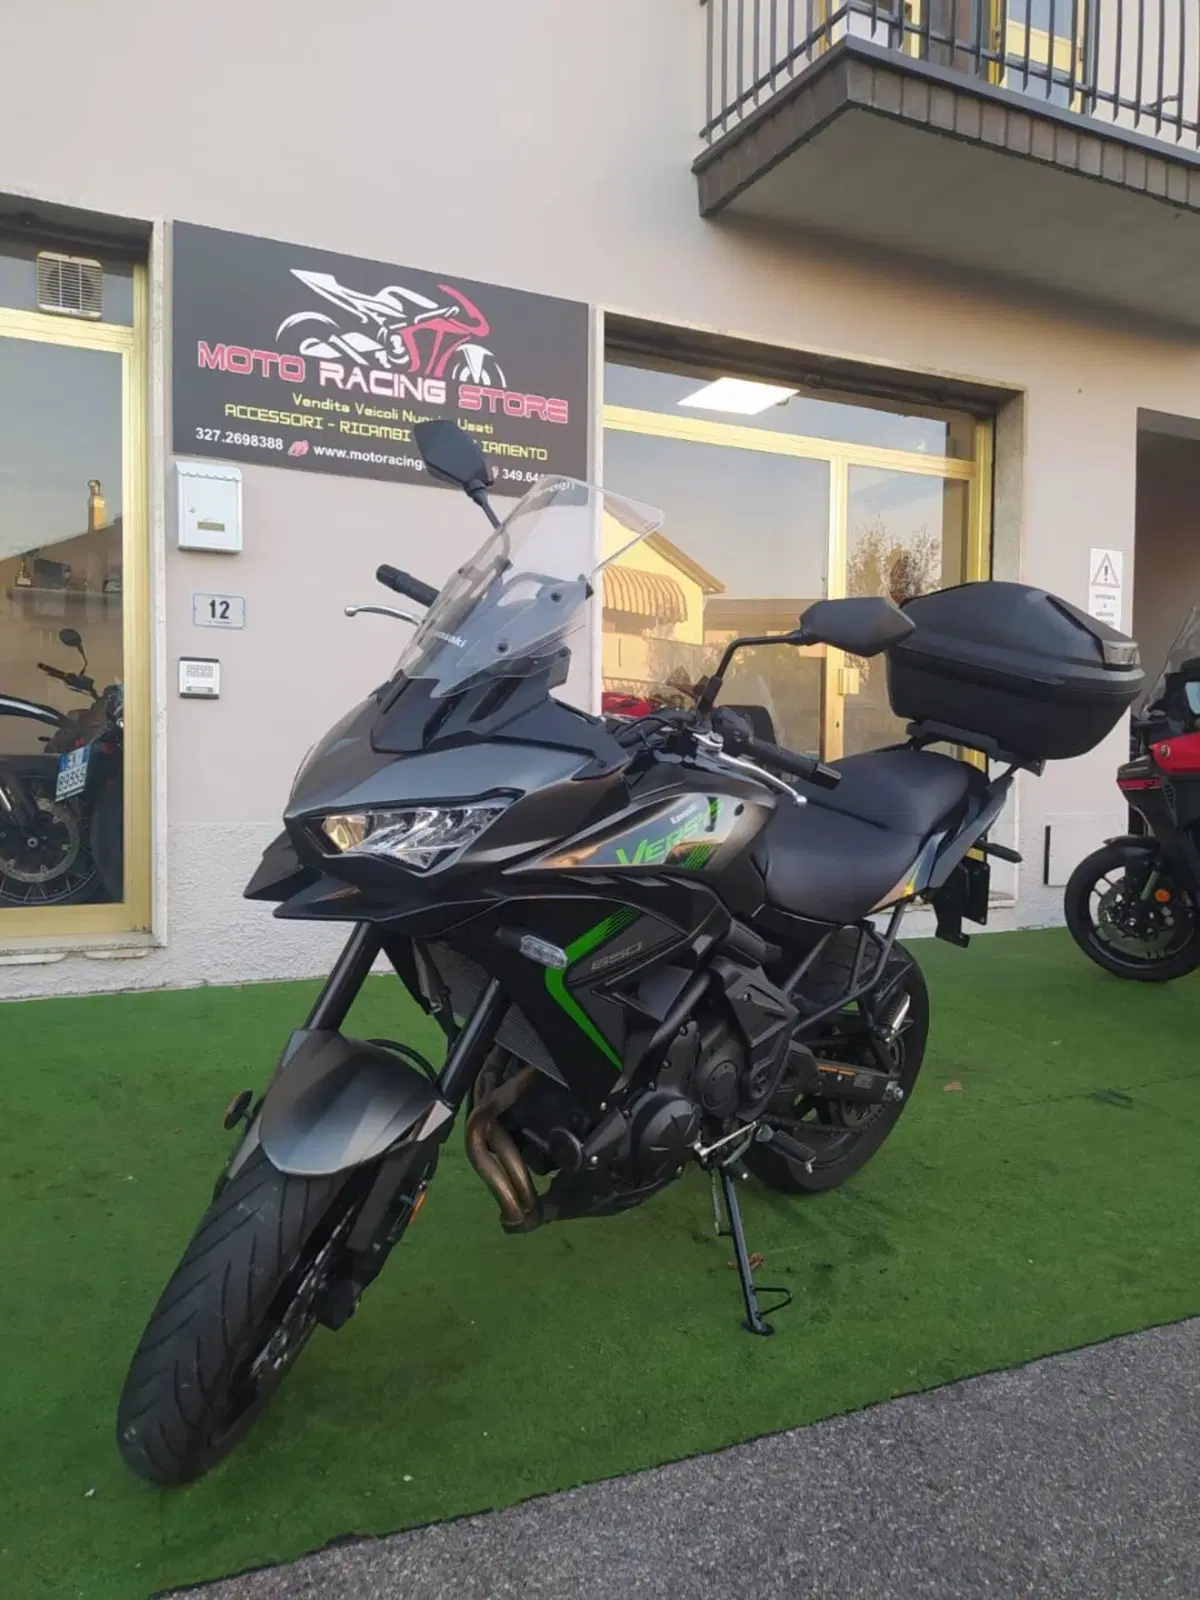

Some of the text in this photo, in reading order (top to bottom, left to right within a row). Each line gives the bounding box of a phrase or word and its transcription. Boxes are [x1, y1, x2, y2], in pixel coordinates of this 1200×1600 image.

[197, 340, 569, 424] MOTO RACING STORE
[224, 403, 324, 430] ACCESSORI
[339, 420, 412, 442] RICAMBI
[473, 439, 548, 461] IAMENTO
[292, 391, 351, 413] Vendita
[354, 401, 399, 420] Veicoli
[457, 417, 494, 434] Usati
[195, 427, 284, 450] 327.2698388
[313, 445, 427, 472] www.motoracing
[208, 599, 231, 619] 12
